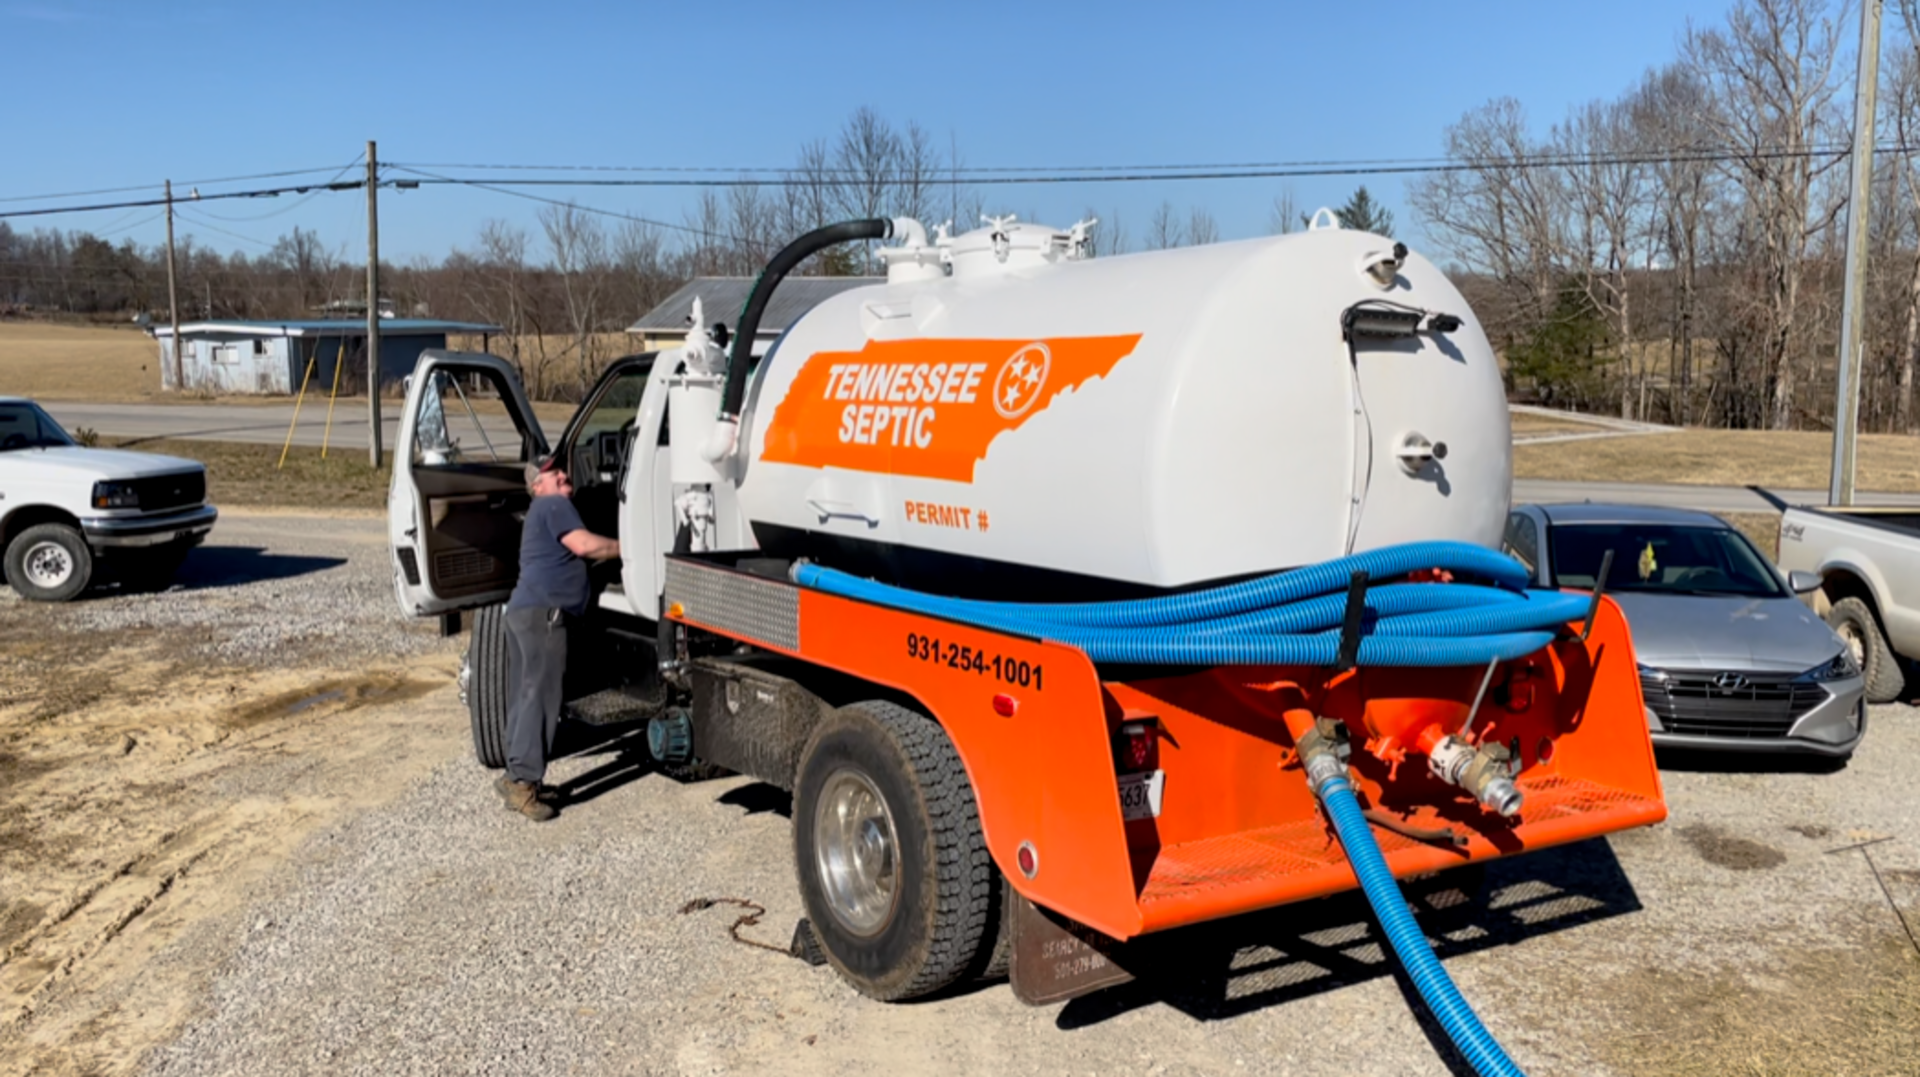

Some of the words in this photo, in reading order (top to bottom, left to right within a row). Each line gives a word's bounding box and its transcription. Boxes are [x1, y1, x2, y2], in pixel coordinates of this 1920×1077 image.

[823, 362, 988, 403] TENNESSEE
[838, 404, 936, 449] SEPTIC
[904, 500, 971, 530] PERMIT
[977, 509, 989, 532] #
[907, 632, 1042, 691] 931-254-1001
